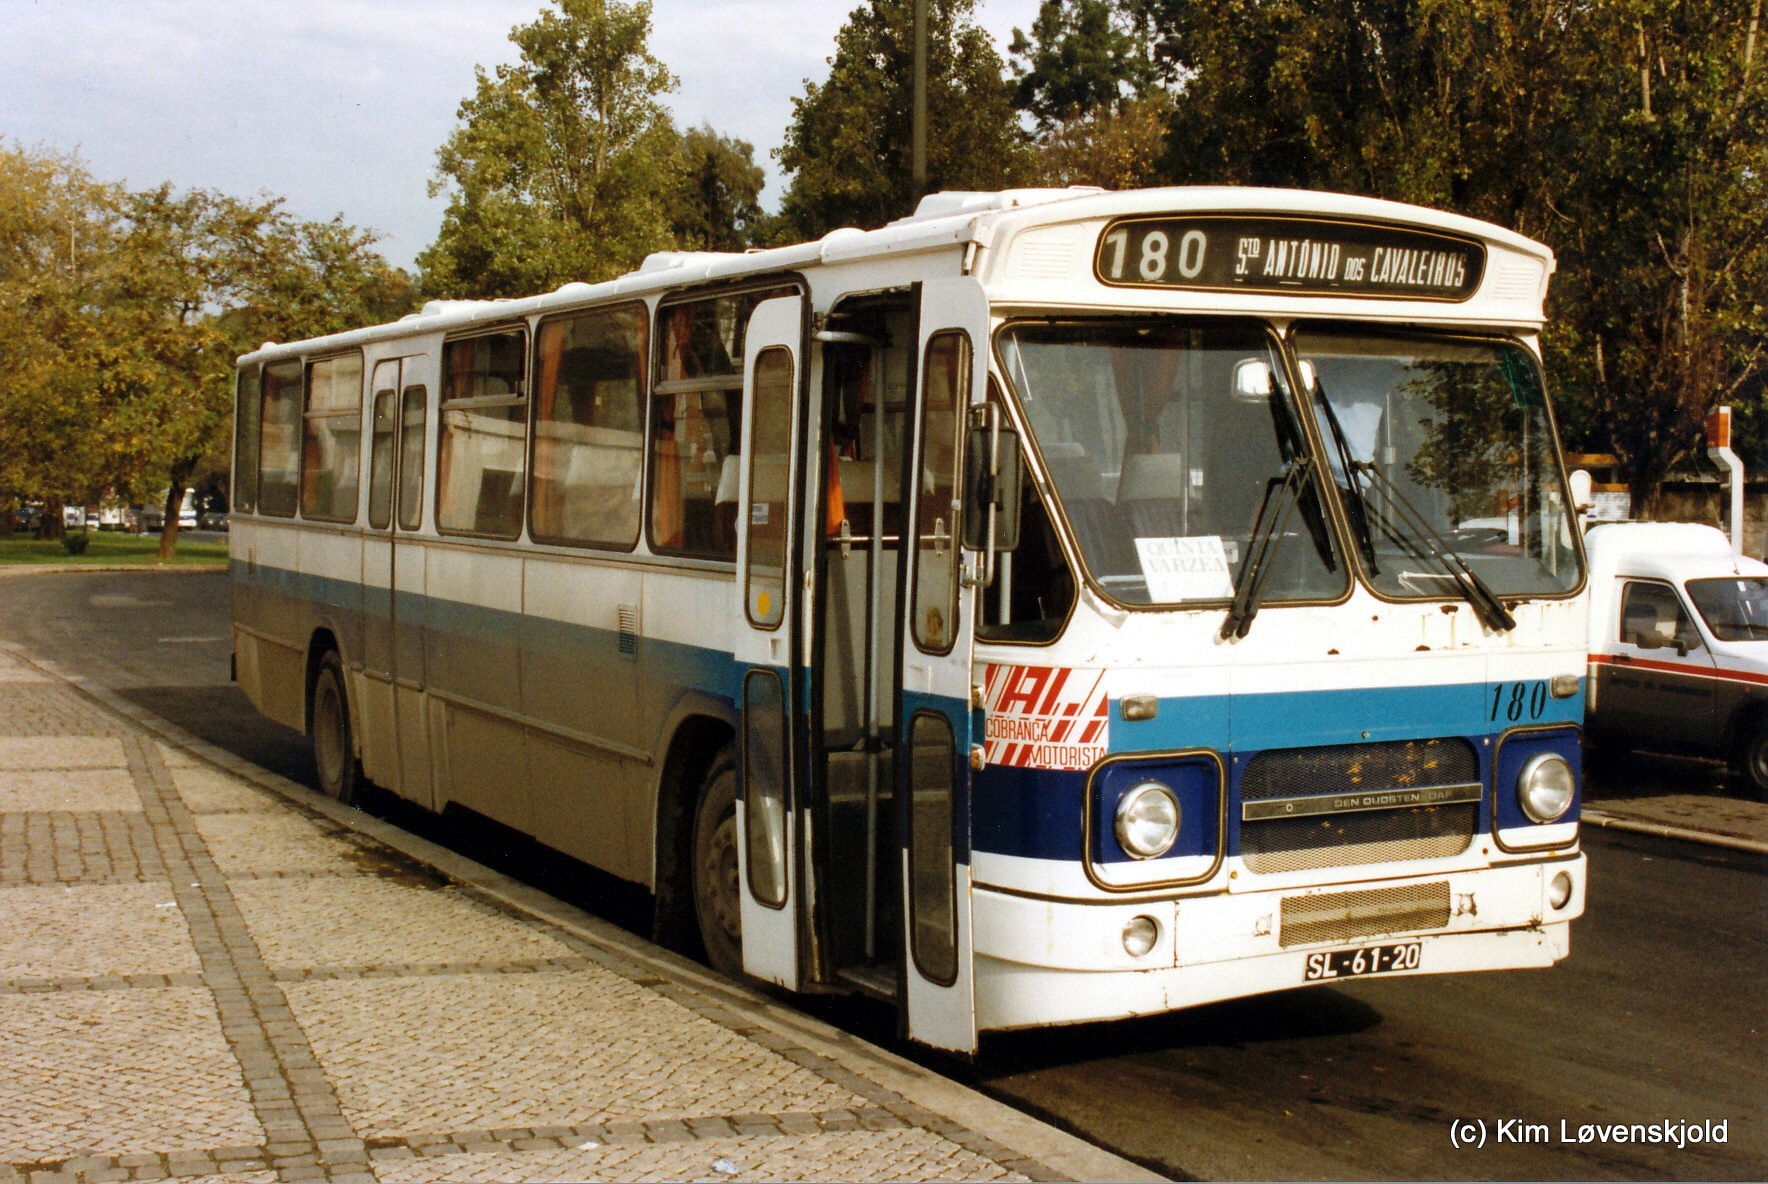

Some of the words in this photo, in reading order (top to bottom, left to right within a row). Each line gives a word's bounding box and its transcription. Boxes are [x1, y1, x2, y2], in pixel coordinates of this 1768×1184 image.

[1105, 229, 1207, 281] 180
[1263, 239, 1340, 280] ANTÓNIO
[1344, 257, 1366, 281] DOS
[1370, 247, 1467, 287] CAVALEIROS
[1491, 681, 1546, 722] 180
[1029, 745, 1107, 767] MOTORISTA
[1334, 798, 1360, 809] DEN
[1363, 793, 1420, 806] OUDSTEN
[1307, 944, 1420, 979] SL-61-20
